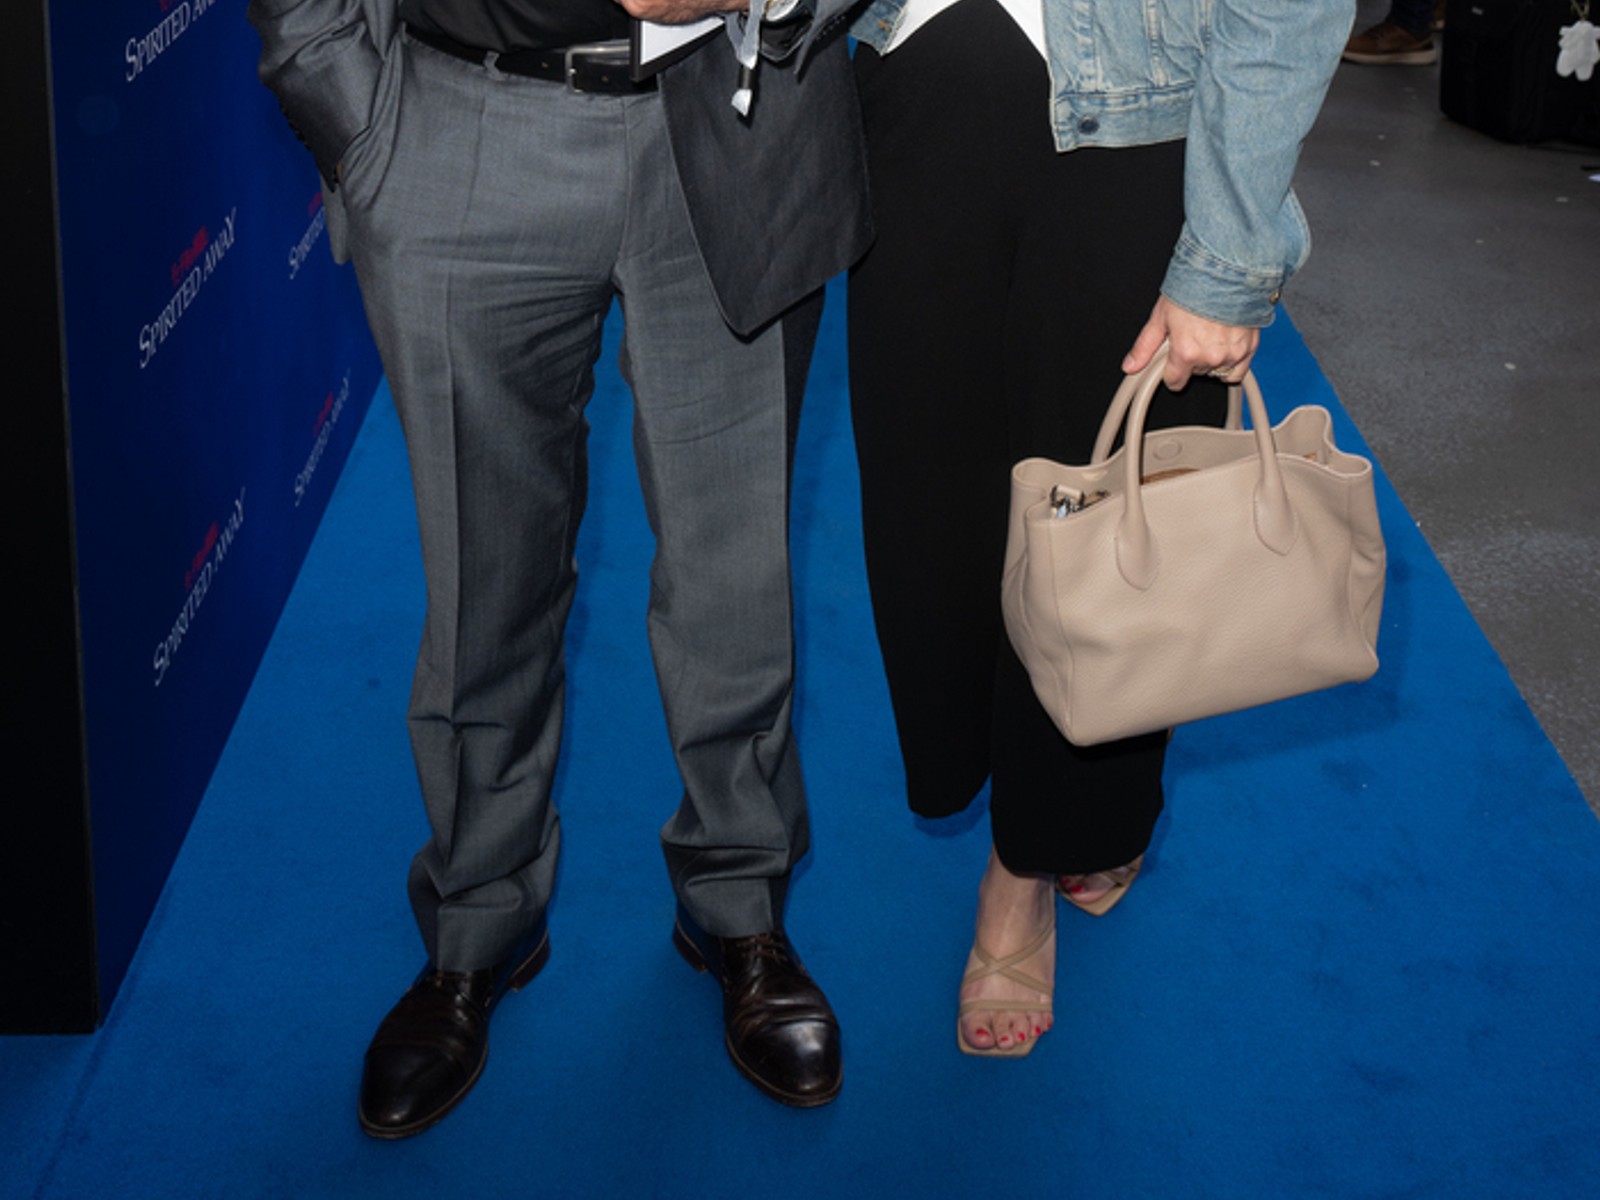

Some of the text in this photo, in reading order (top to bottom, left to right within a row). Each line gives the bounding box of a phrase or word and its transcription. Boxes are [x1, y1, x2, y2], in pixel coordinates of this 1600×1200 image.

[126, 1, 191, 82] SPIRITED
[139, 266, 201, 369] SPIRITED
[203, 206, 237, 282] AWAY
[154, 562, 211, 687] SPIRITED
[213, 486, 246, 573] AWAY
